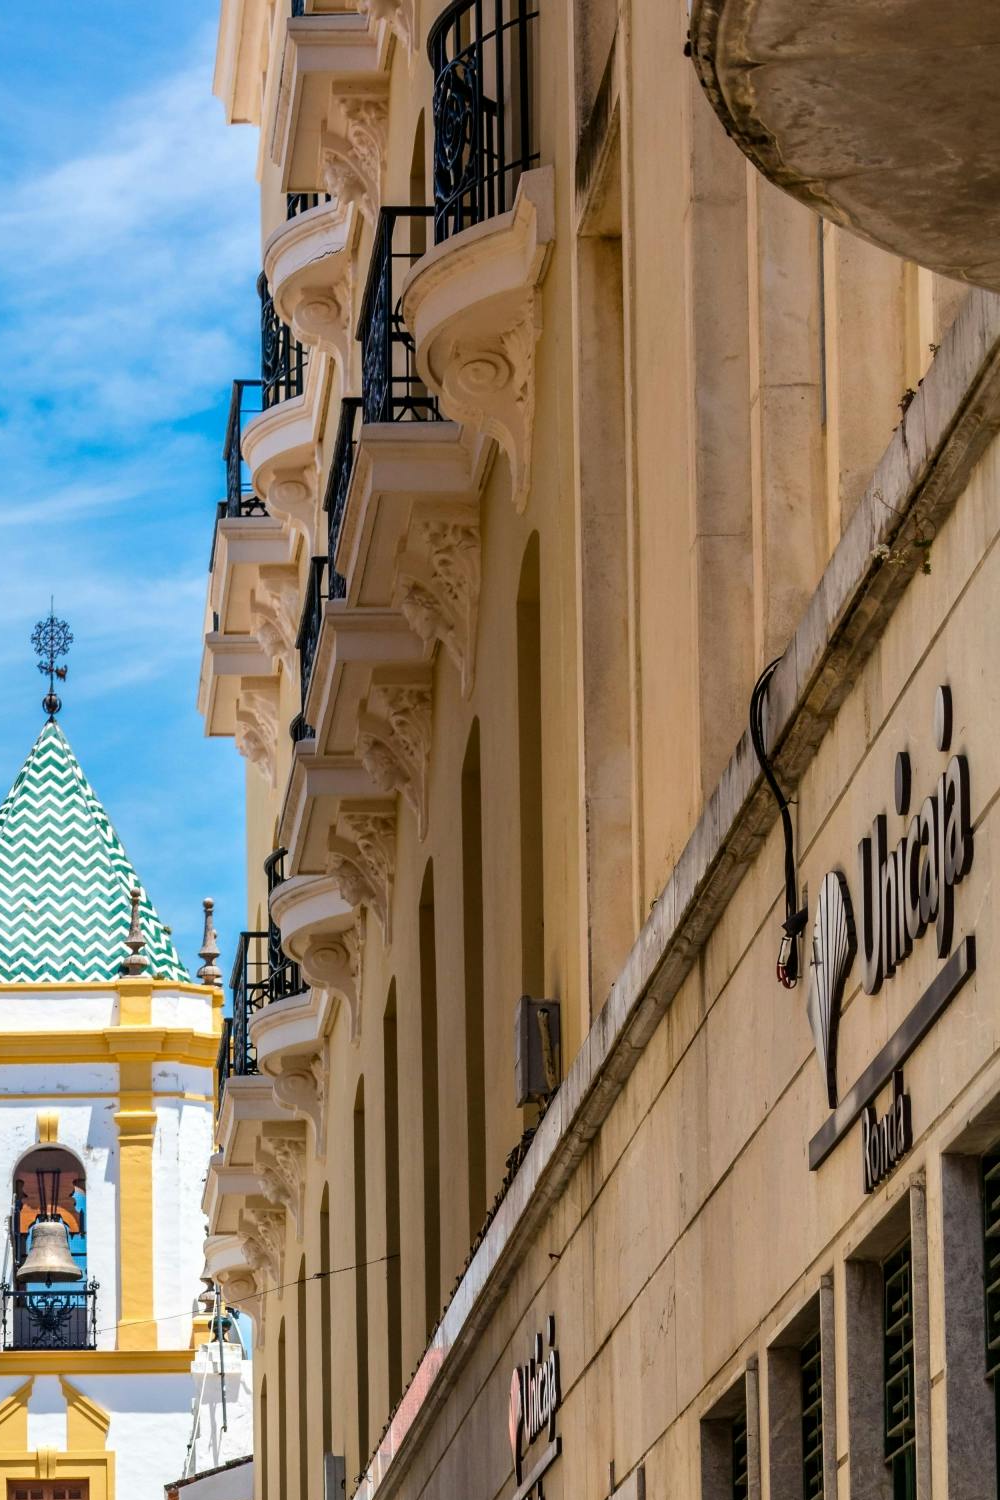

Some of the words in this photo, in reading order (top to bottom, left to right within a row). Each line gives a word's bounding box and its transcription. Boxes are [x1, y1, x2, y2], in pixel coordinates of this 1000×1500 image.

[858, 684, 974, 996] Unicaja
[862, 1069, 912, 1194] Ronda
[523, 1314, 560, 1444] Unicaja
